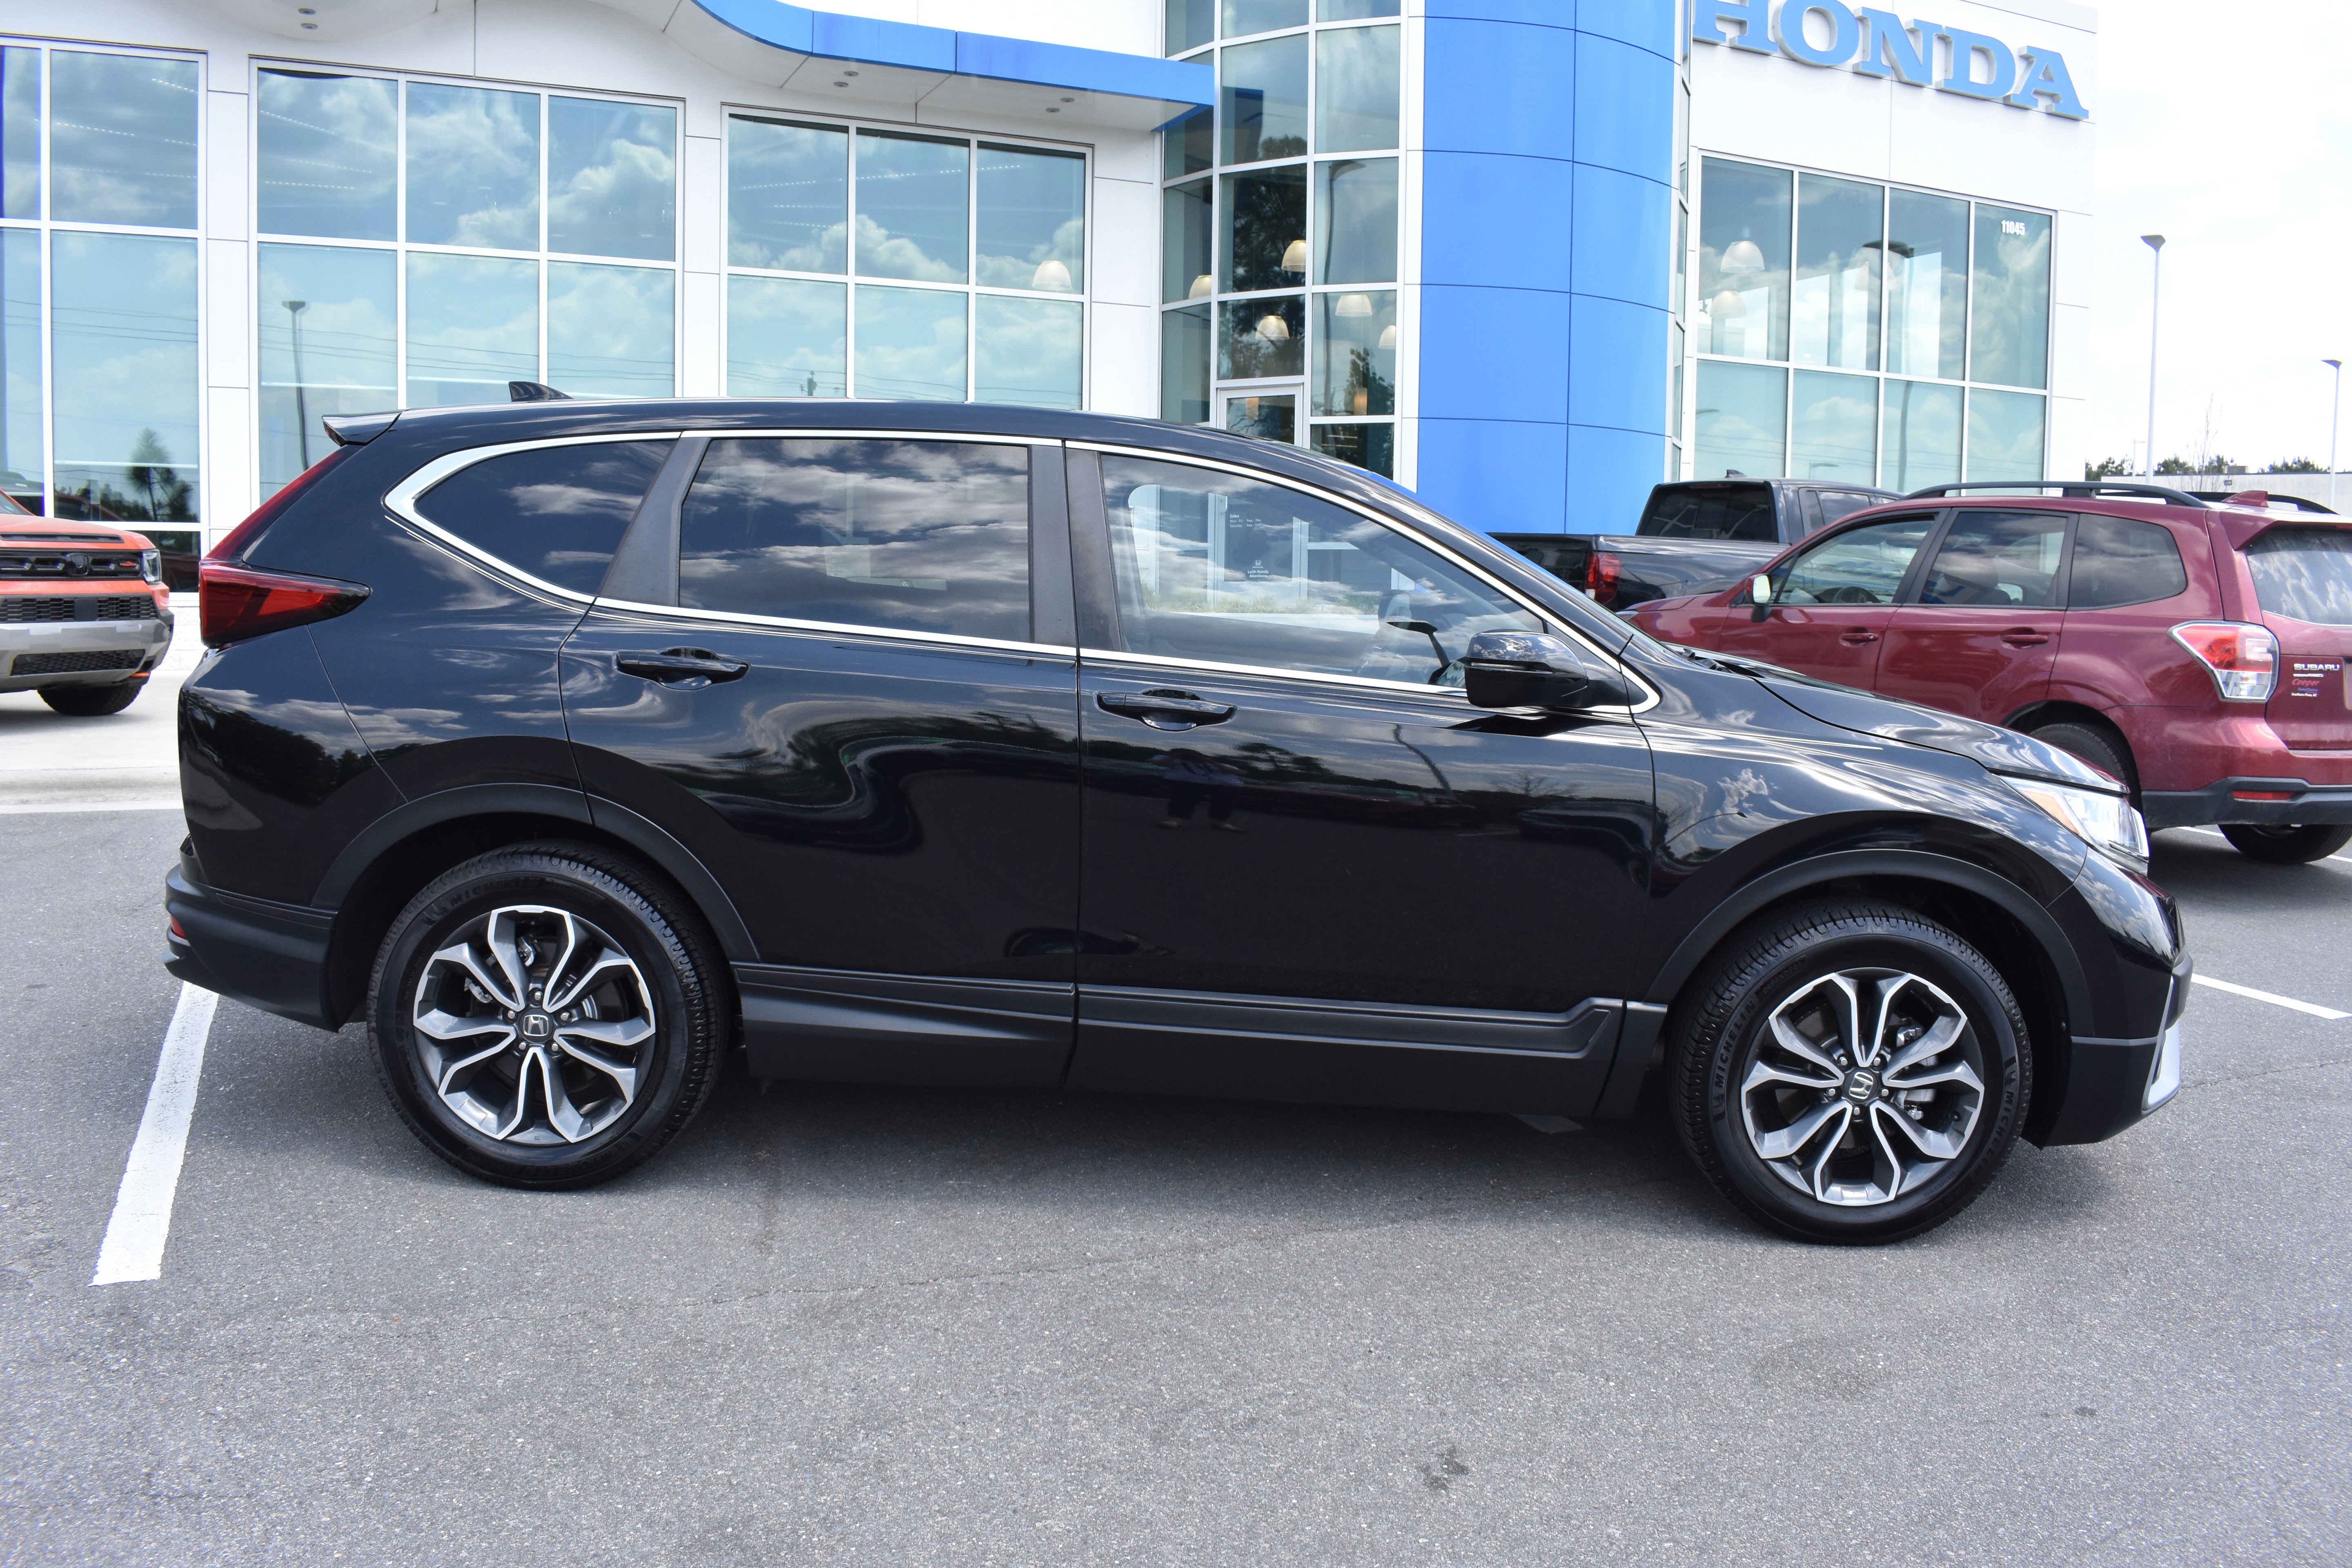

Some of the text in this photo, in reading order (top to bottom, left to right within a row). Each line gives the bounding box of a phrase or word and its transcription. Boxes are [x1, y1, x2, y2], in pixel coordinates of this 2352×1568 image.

[1693, 0, 2089, 120] HONDA
[2001, 220, 2025, 235] 11045
[2292, 678, 2320, 686] Cooper
[1714, 1000, 1756, 1089] MICHELIN
[1973, 1090, 2015, 1176] MICHELIN
